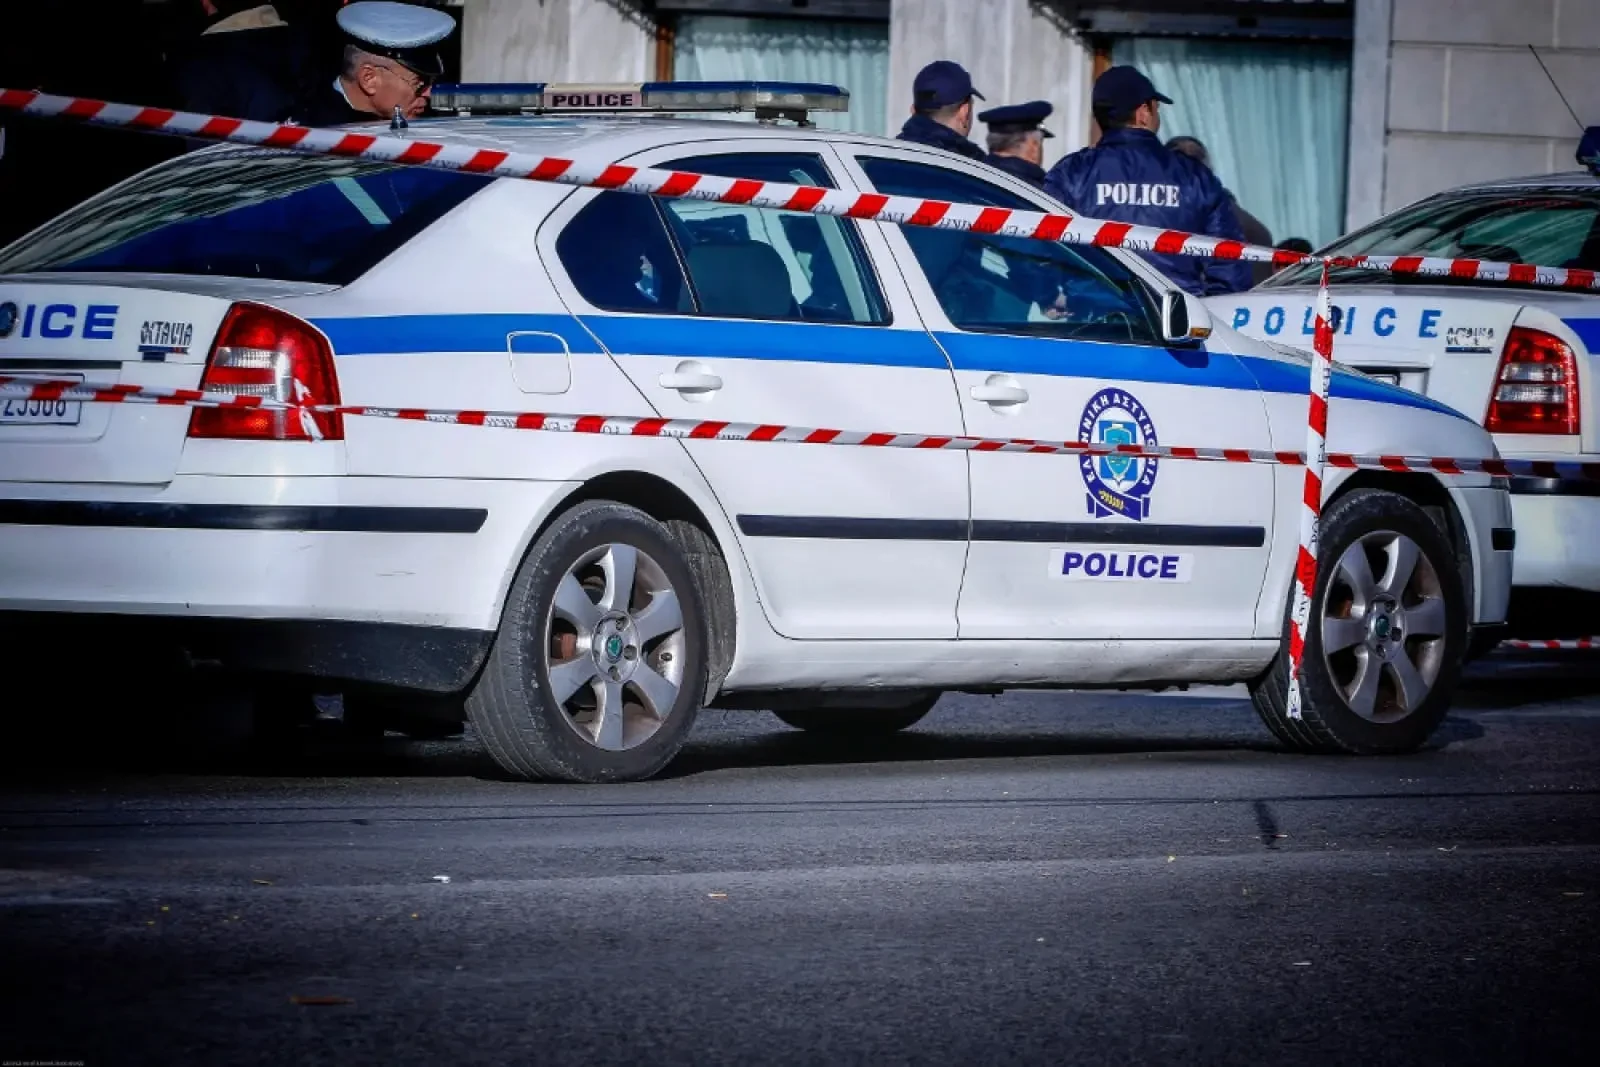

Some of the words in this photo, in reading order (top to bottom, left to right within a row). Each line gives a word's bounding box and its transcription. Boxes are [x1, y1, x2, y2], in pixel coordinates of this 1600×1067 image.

[552, 93, 633, 107] POLICE
[1096, 183, 1180, 207] POLICE
[1062, 551, 1180, 579] POLICE
